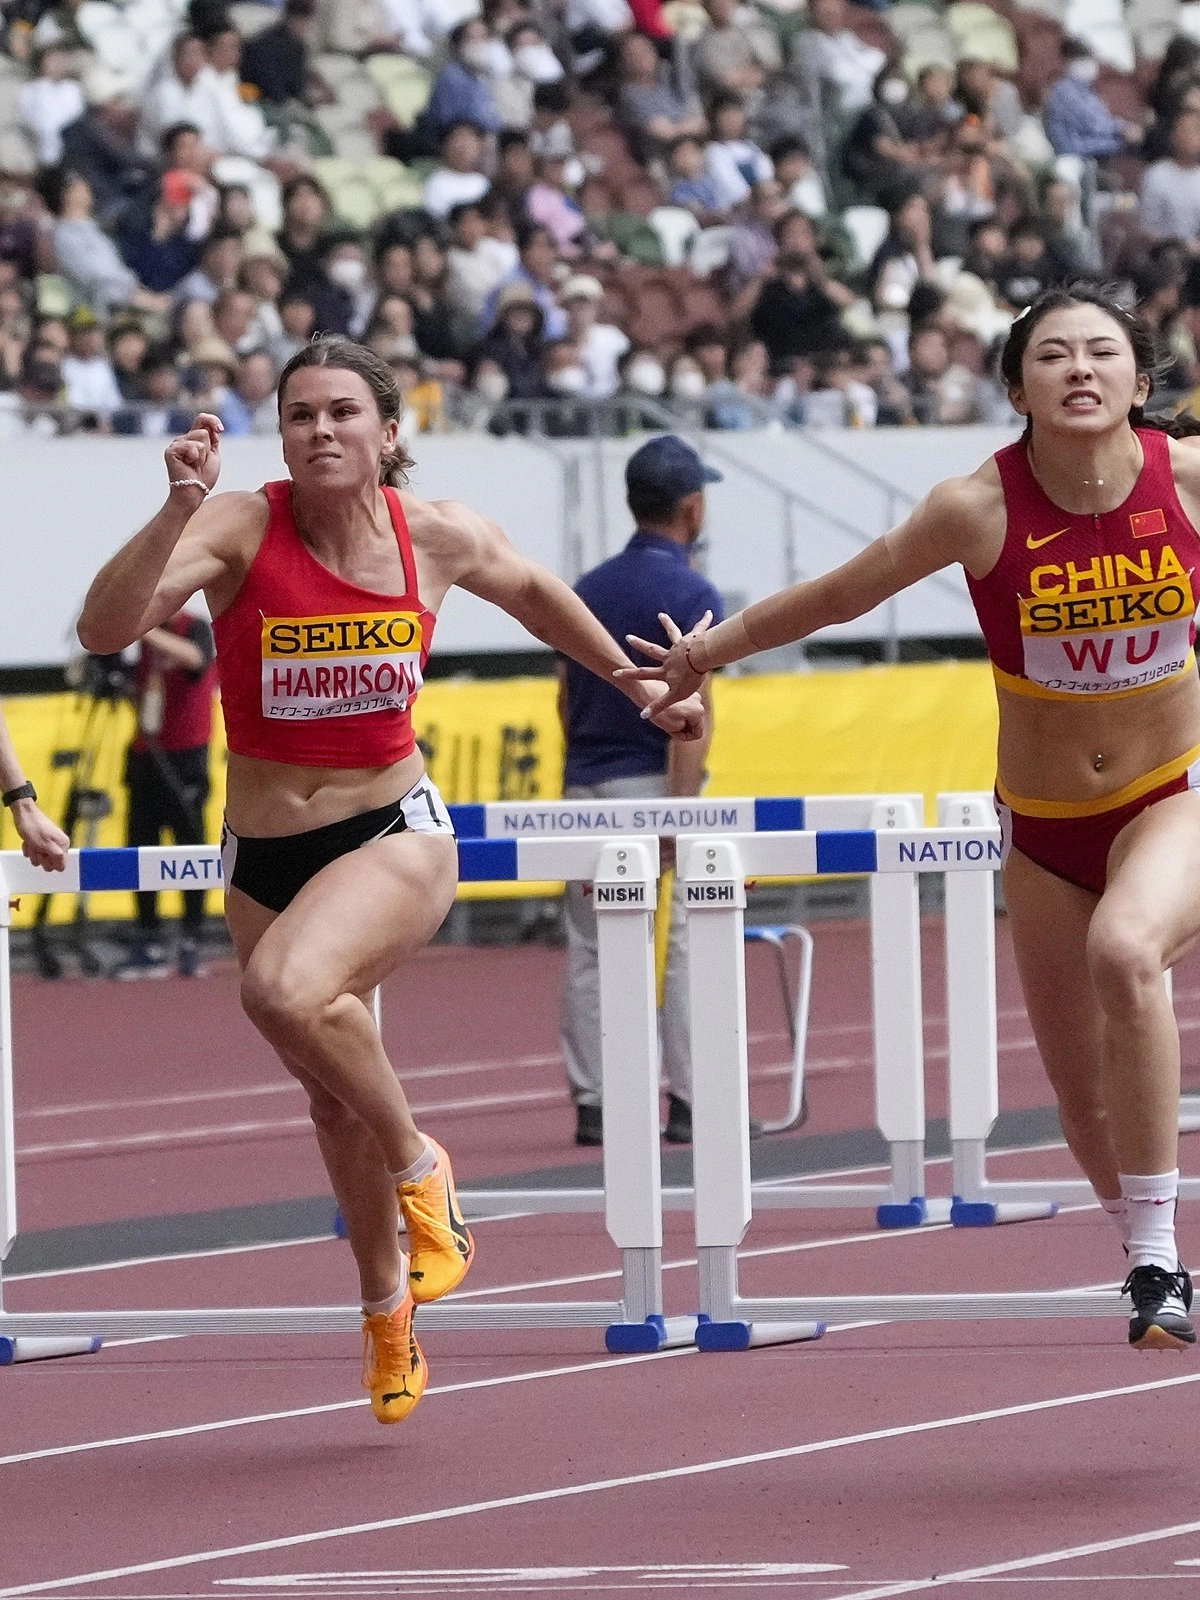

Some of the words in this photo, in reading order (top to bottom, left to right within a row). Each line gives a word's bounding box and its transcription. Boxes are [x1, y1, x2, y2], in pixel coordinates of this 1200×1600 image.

[1030, 545, 1186, 597] CHINA
[1029, 585, 1185, 633] SEIKO
[270, 618, 415, 654] SEIKO
[1061, 631, 1160, 674] WU
[272, 661, 417, 699] HARRISON
[411, 786, 442, 828] 7
[504, 810, 624, 832] NATIONAL
[633, 808, 738, 828] STADIUM
[899, 839, 1002, 863] NATION
[597, 887, 645, 902] NISHI
[687, 885, 734, 901] NISHI
